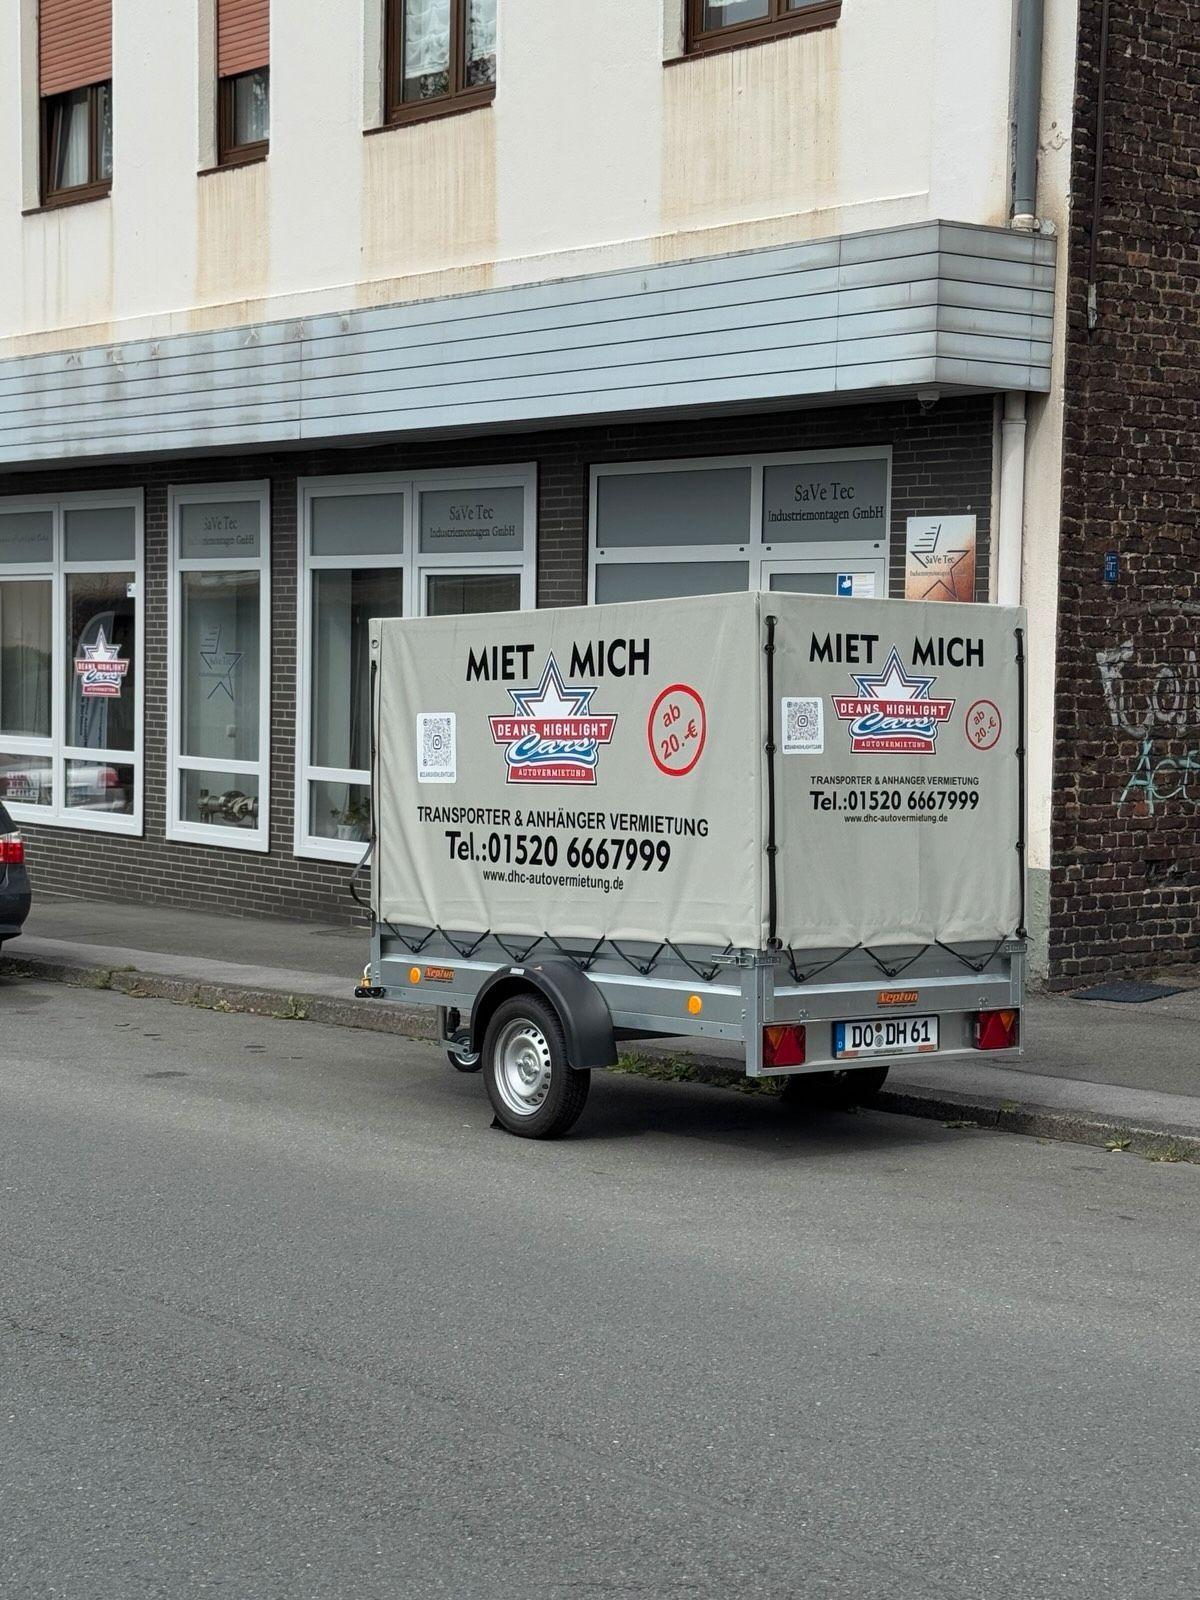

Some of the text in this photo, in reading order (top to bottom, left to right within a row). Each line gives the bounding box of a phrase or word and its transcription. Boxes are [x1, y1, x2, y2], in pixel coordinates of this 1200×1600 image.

[794, 483, 855, 502] SaVe Tec
[449, 504, 494, 520] SaVe Tec
[768, 506, 884, 523] Industriemontagen GmbH
[223, 516, 238, 529] Tec
[492, 525, 515, 537] GmbH
[925, 555, 955, 565] SaVe Tec
[809, 632, 984, 667] MIET MICH
[466, 638, 650, 682] MIET MICH
[663, 704, 681, 728] ab
[840, 703, 947, 716] DEANS HIGHLIGHT
[972, 709, 986, 727] ab
[497, 723, 608, 736] DEANS HIGHLIGHT
[852, 711, 936, 737] Cars
[508, 733, 597, 761] Cars
[861, 740, 926, 749] AUTOVERMIETUNG
[518, 768, 586, 777] AUTOVERMIETUNG
[811, 775, 872, 785] TRANSPORTER
[874, 776, 881, 785] &
[927, 776, 979, 786] VERMIETUNG
[809, 790, 980, 811] Tel.:01520 6667999
[417, 806, 709, 837] TRANSPORTER & ANHÄNGER VERMIETUNG
[844, 813, 949, 824] www.dhc-autovermietung.de
[445, 830, 671, 872] Tel.:01520 6667999
[483, 869, 624, 894] www.dhc-autovermietung.de
[851, 1020, 930, 1048] DO DH 61
